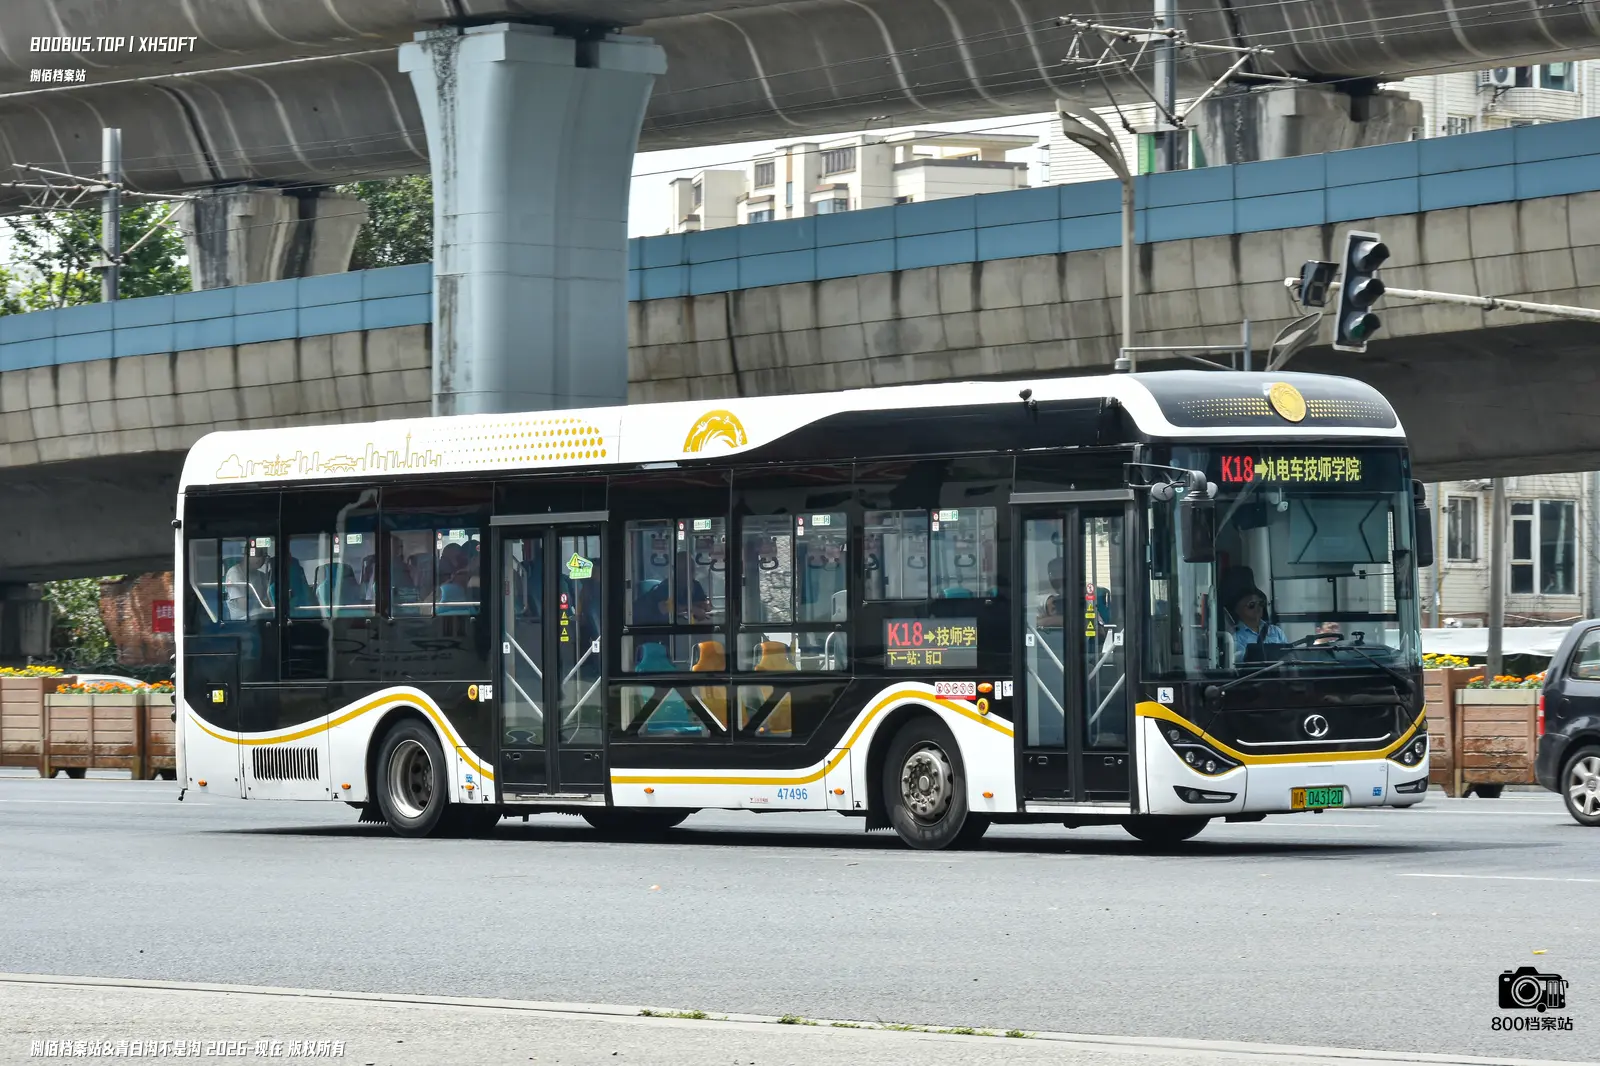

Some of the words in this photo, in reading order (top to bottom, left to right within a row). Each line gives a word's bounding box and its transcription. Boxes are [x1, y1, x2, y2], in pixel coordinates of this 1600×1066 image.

[1221, 455, 1255, 482] K18
[1267, 456, 1362, 482] 电车技师学院
[887, 621, 924, 647] K18
[936, 626, 977, 647] 技师学
[777, 788, 808, 800] 47496
